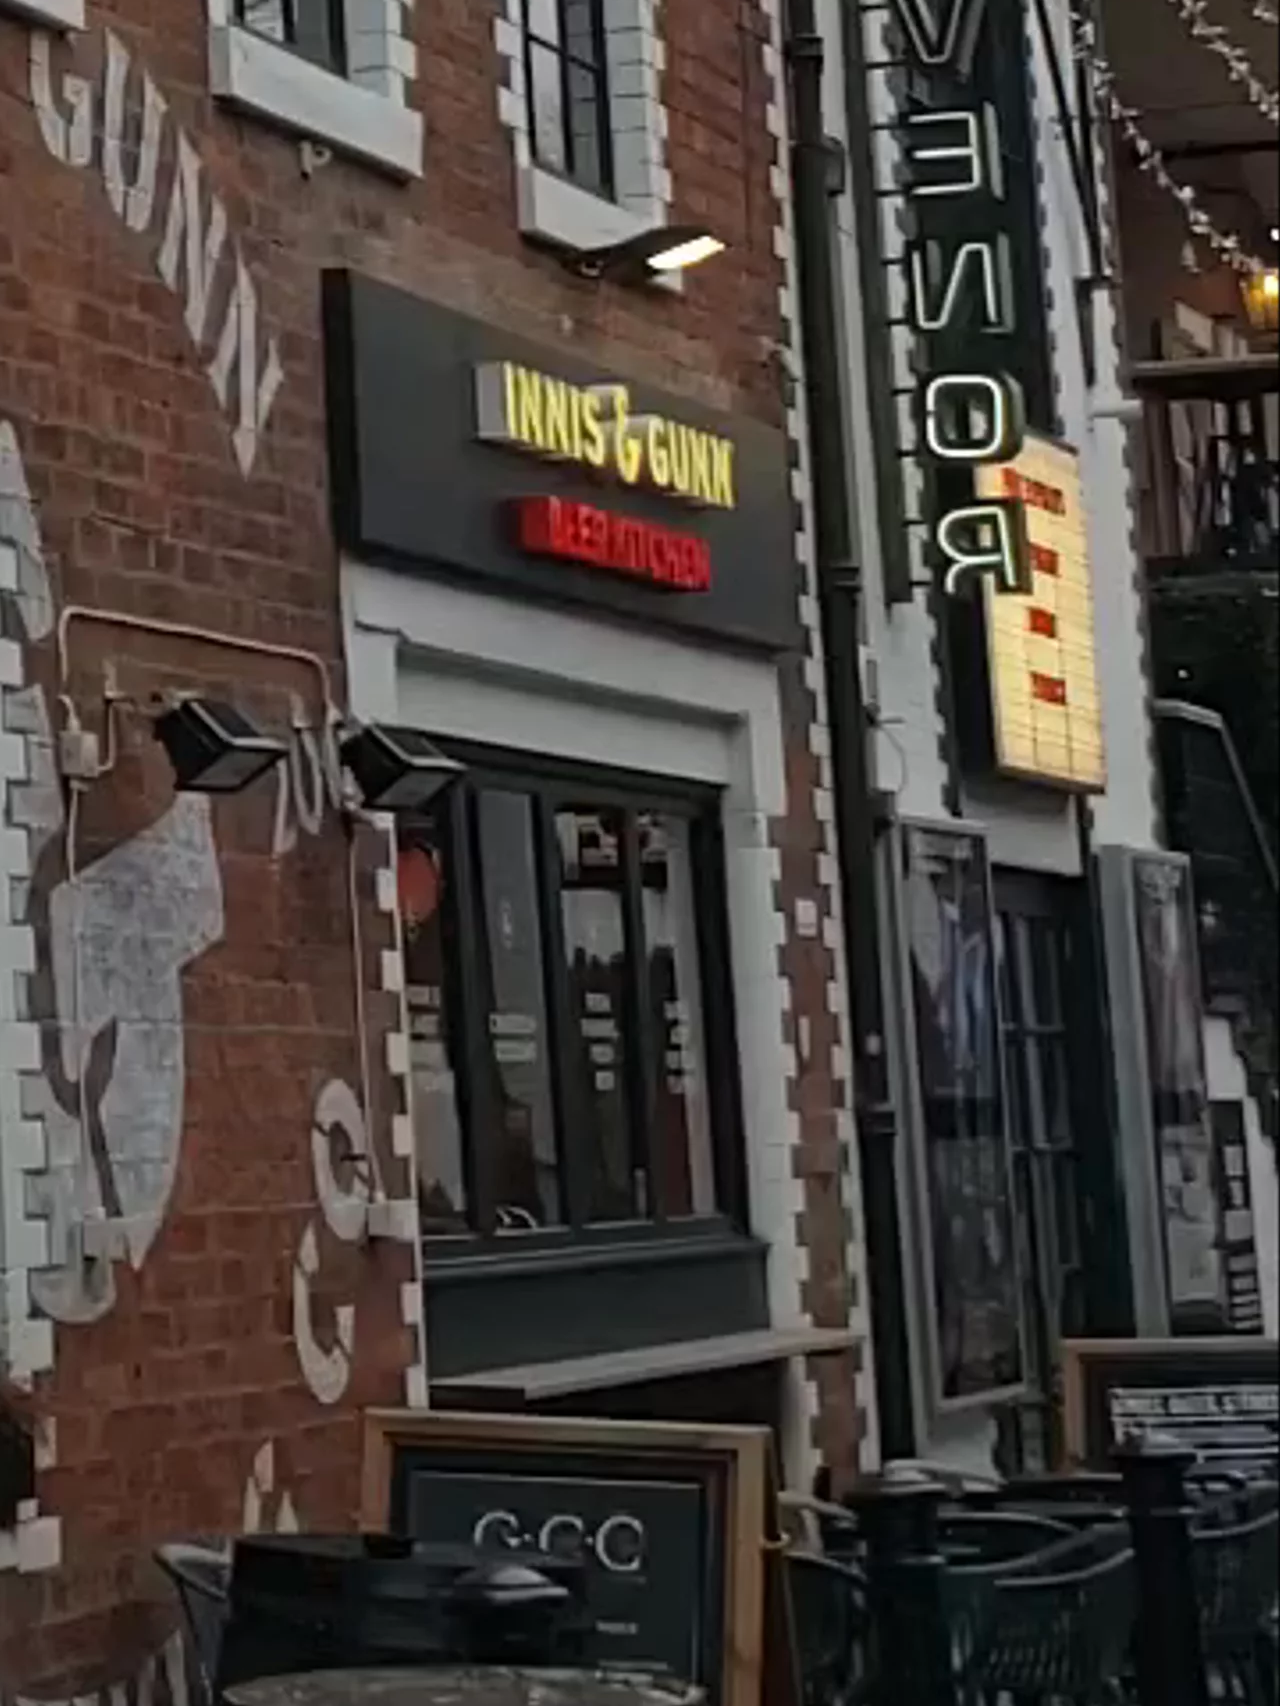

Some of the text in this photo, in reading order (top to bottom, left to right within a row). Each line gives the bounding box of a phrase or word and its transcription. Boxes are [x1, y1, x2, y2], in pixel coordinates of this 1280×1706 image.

[28, 24, 285, 483] GUNN
[500, 360, 604, 468] INNIS
[648, 414, 736, 510] GUNN
